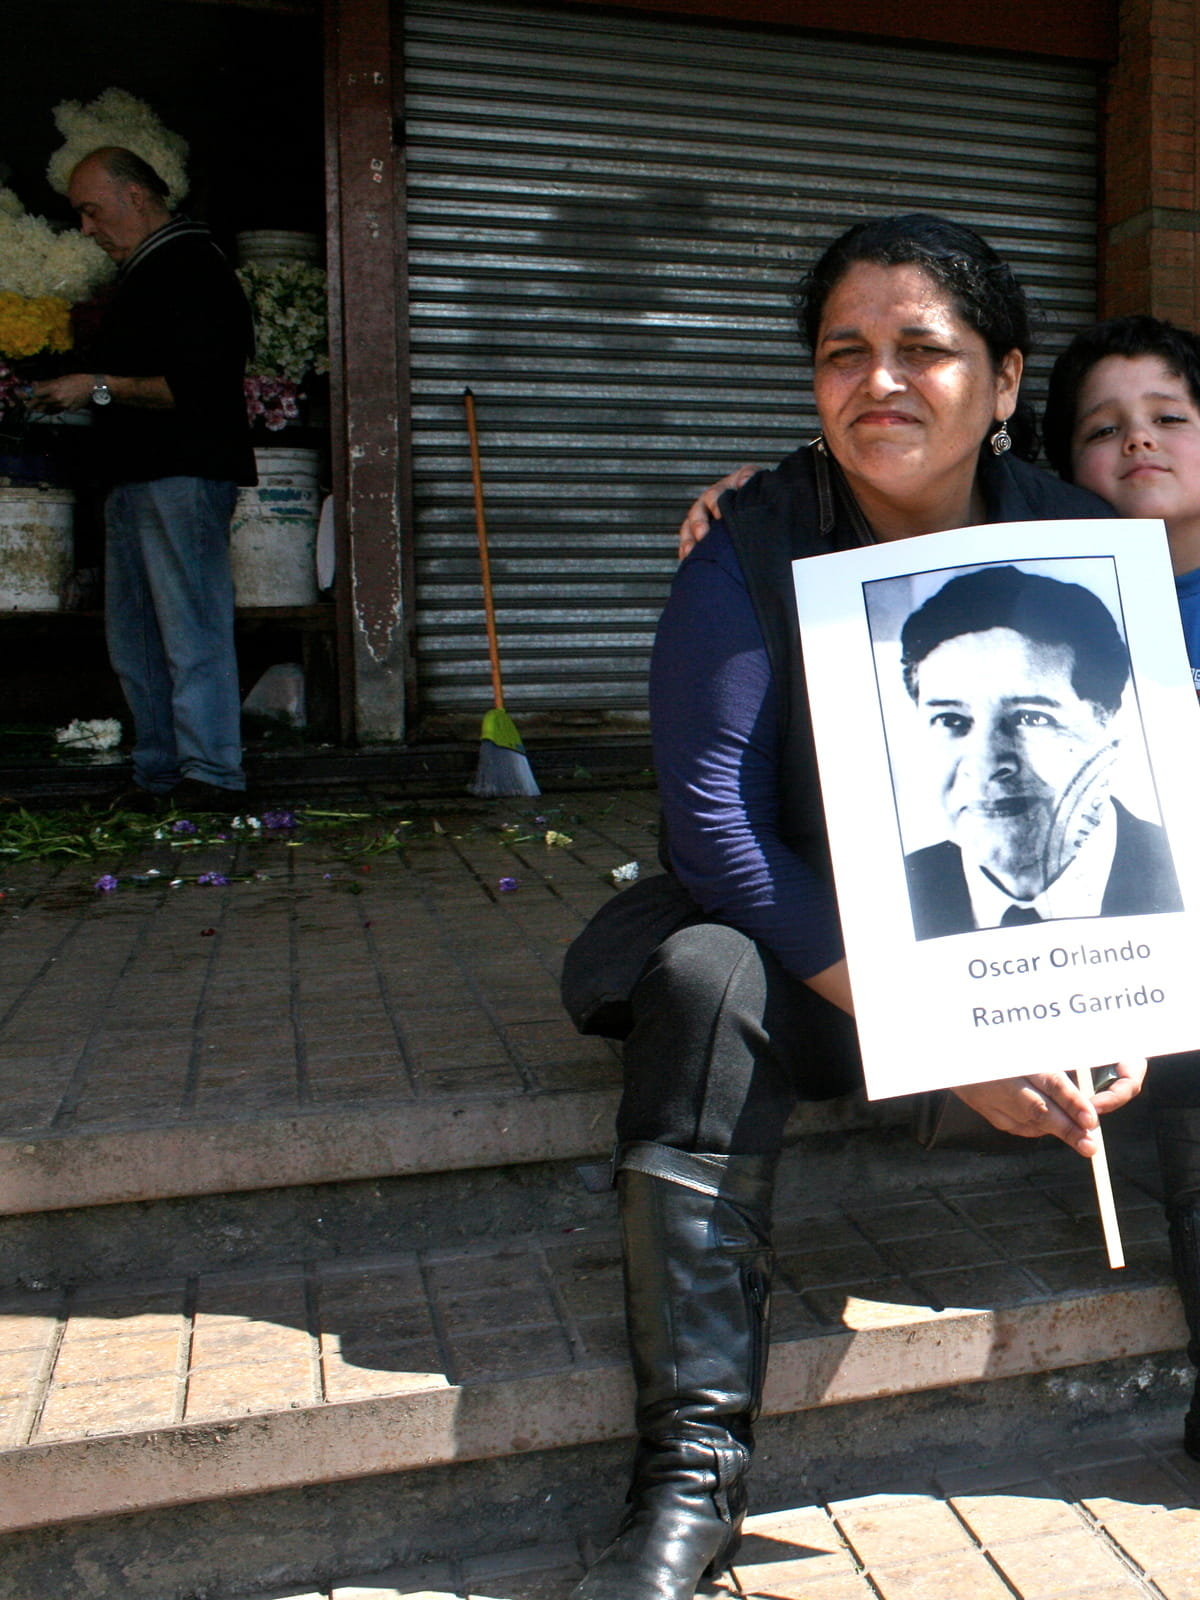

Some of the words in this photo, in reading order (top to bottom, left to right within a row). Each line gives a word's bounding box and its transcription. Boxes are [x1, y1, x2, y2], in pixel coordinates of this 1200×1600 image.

[968, 955, 1040, 979] Oscar
[1048, 940, 1151, 968] Orlando
[972, 1000, 1061, 1027] Ramos
[1068, 985, 1165, 1014] Garrido
